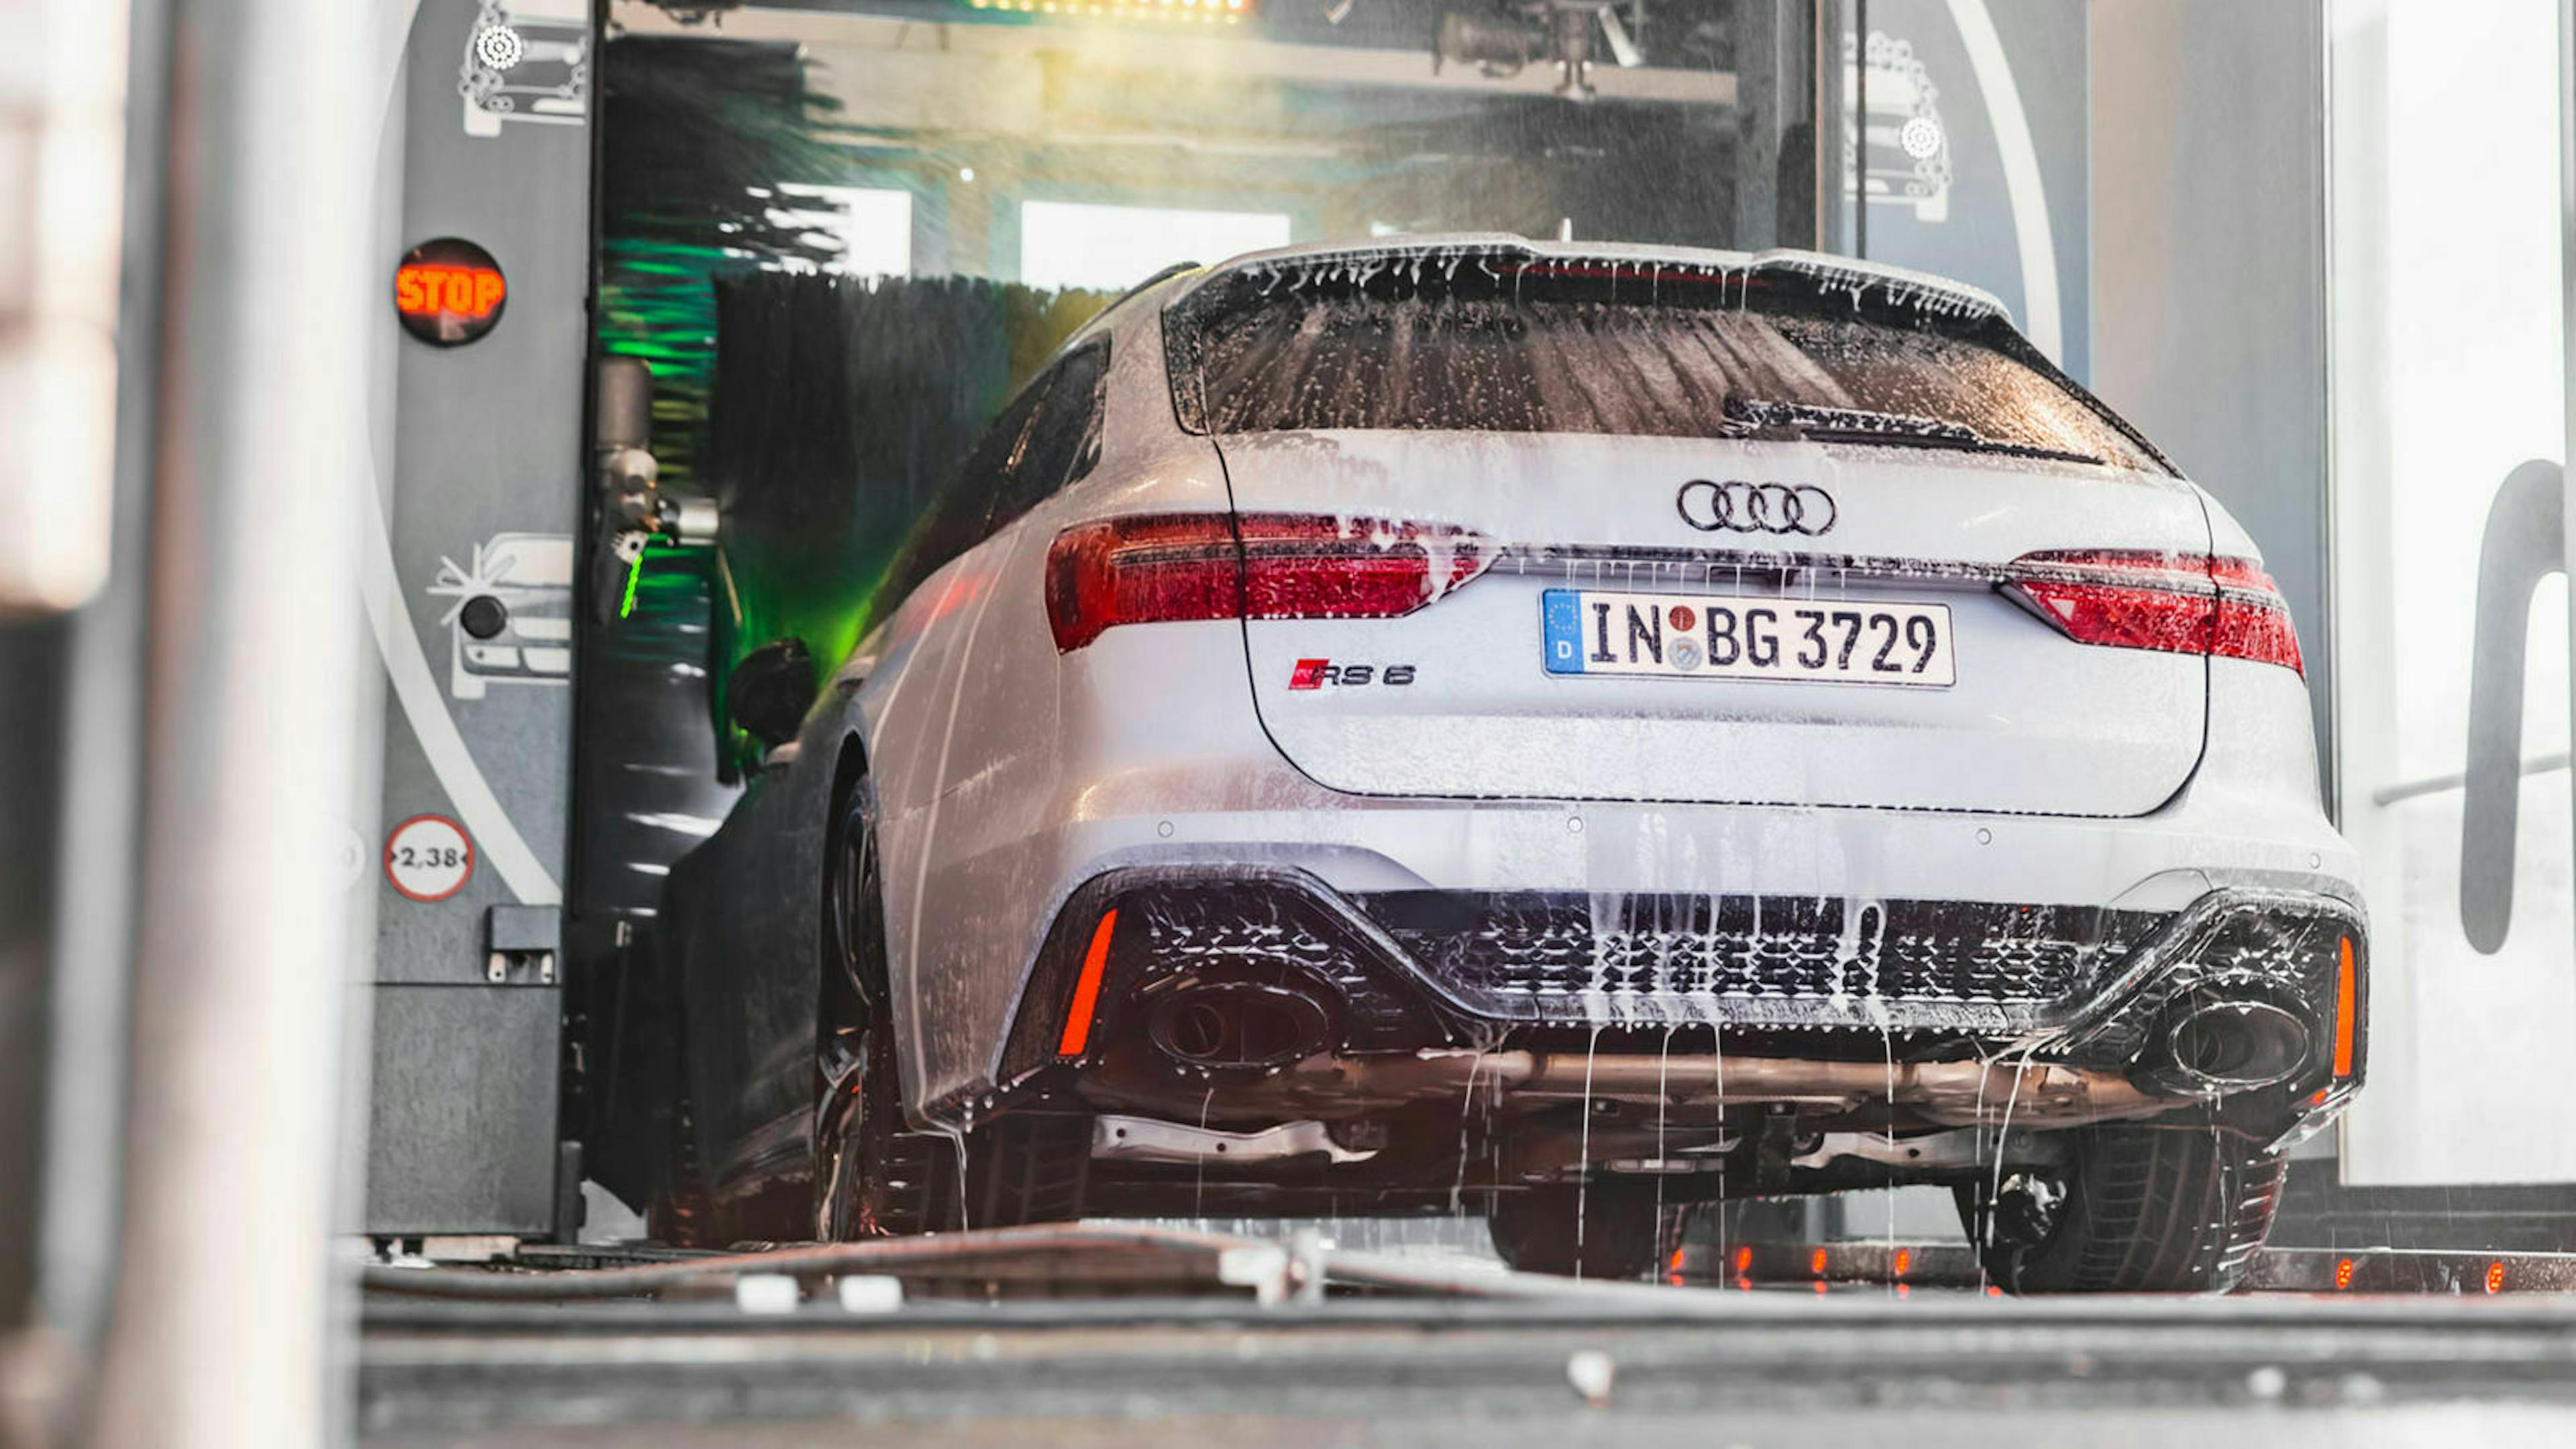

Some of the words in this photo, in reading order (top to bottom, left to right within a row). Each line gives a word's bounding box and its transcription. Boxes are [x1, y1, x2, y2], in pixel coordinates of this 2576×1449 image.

[396, 269, 506, 319] STOP
[1591, 603, 1662, 664] IN
[1706, 606, 1779, 668] BG
[1795, 609, 1936, 673] 3729
[1558, 642, 1572, 659] D
[1310, 665, 1374, 686] RS
[1383, 665, 1417, 685] 6
[401, 847, 458, 869] 2,38
